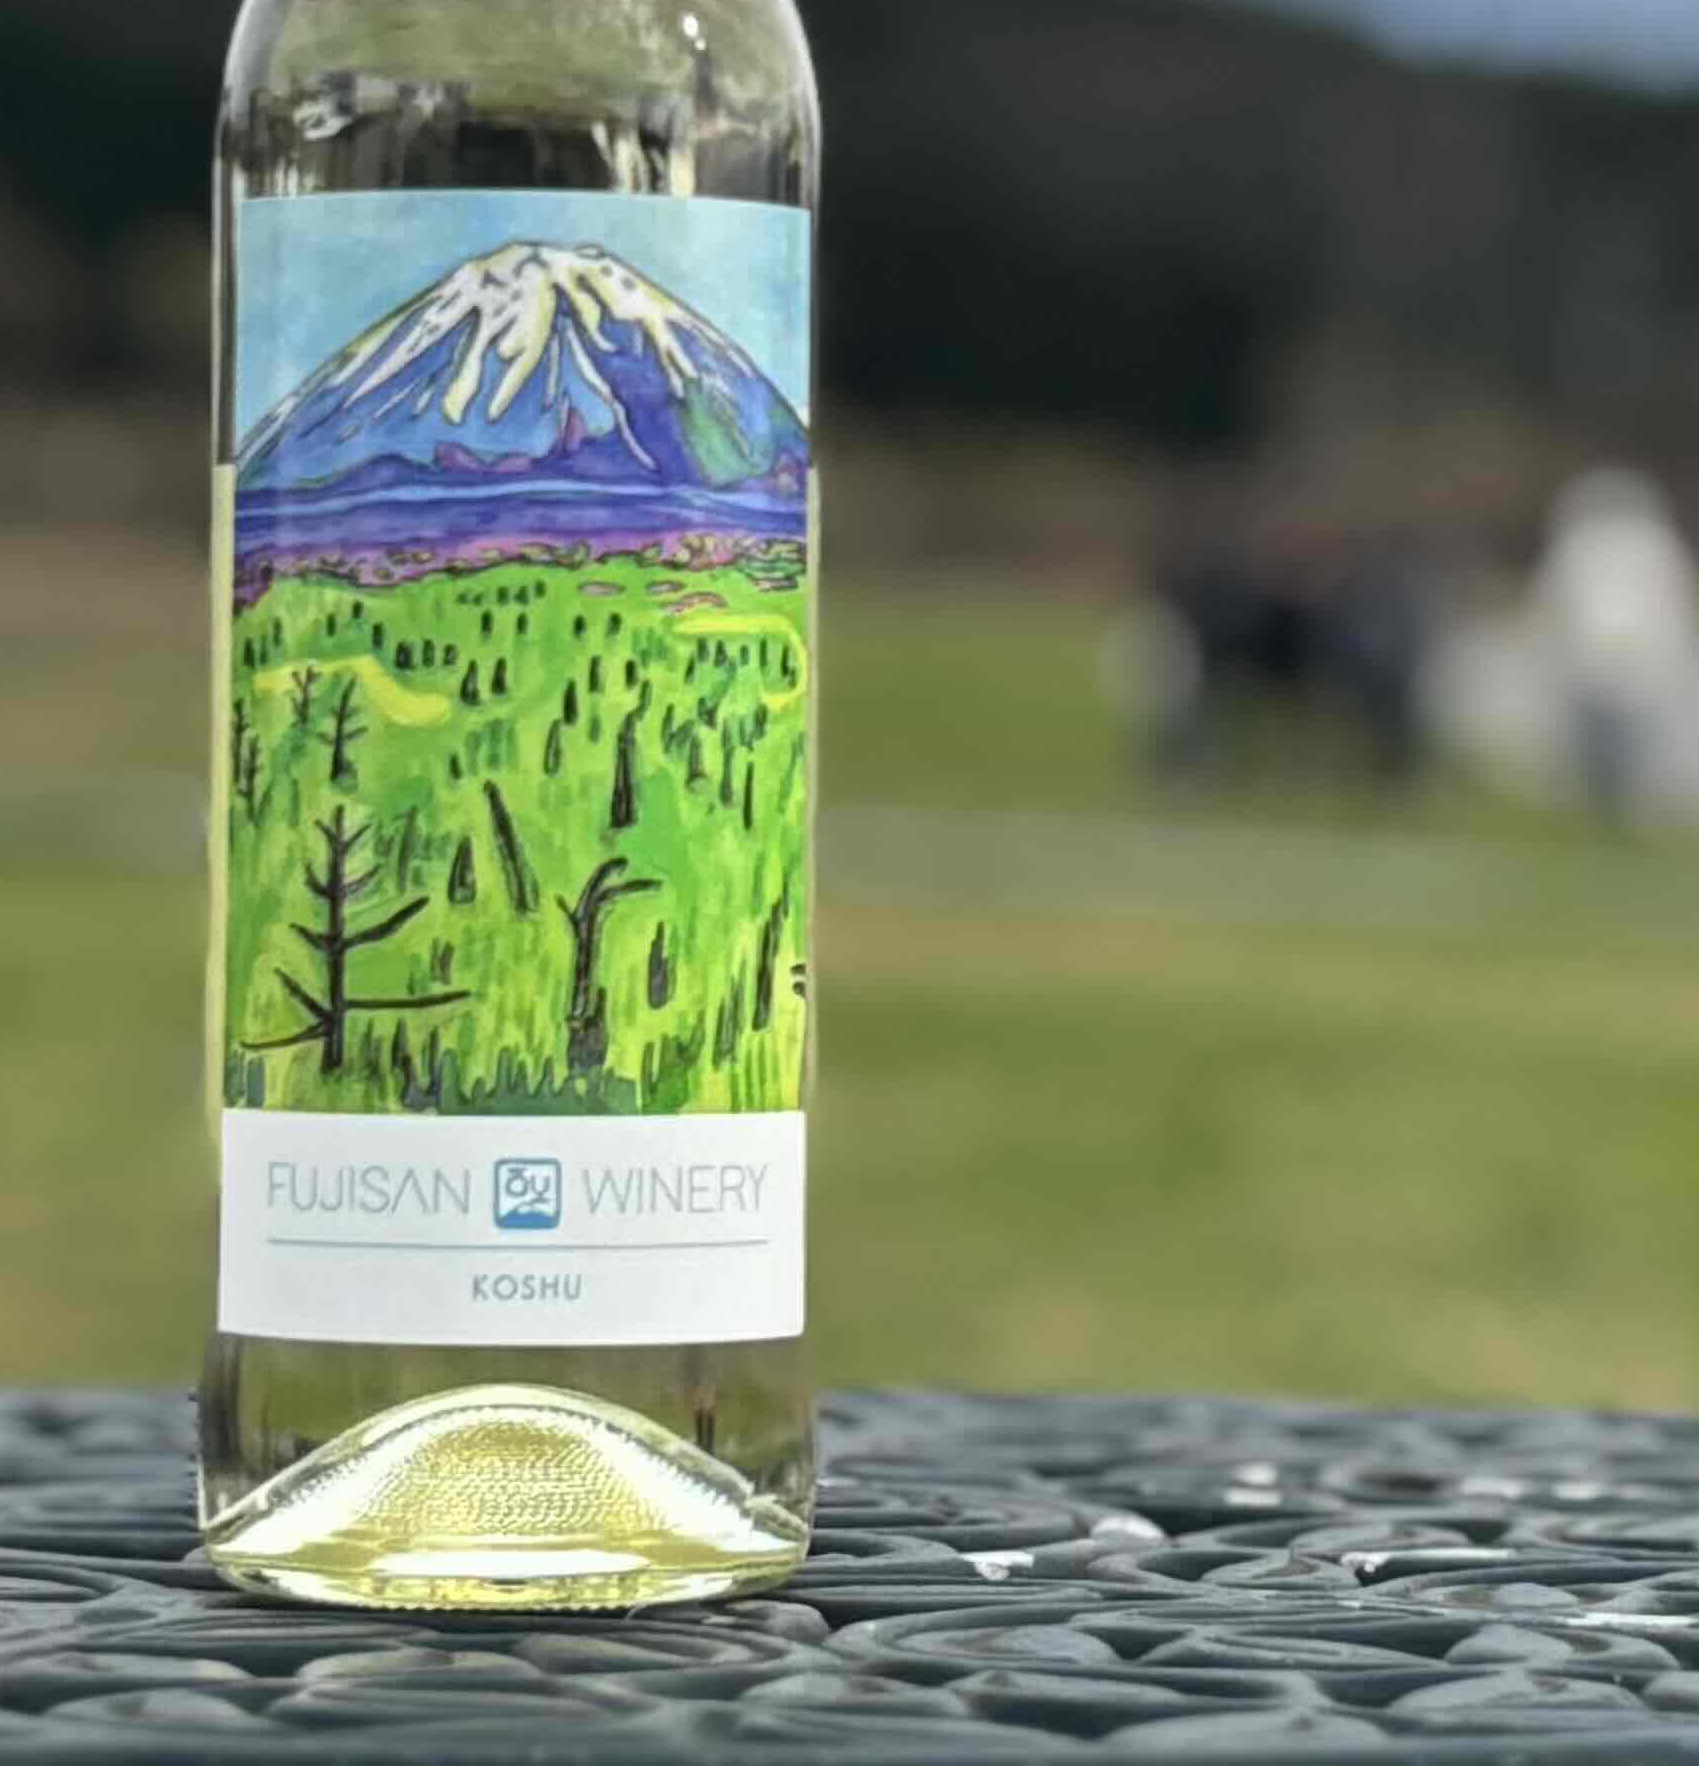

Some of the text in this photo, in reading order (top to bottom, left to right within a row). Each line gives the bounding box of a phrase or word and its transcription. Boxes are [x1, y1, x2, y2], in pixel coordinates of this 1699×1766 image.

[267, 1161, 471, 1215] FUJISAN
[581, 1163, 769, 1215] WINERY
[471, 1273, 583, 1301] KOSHU
